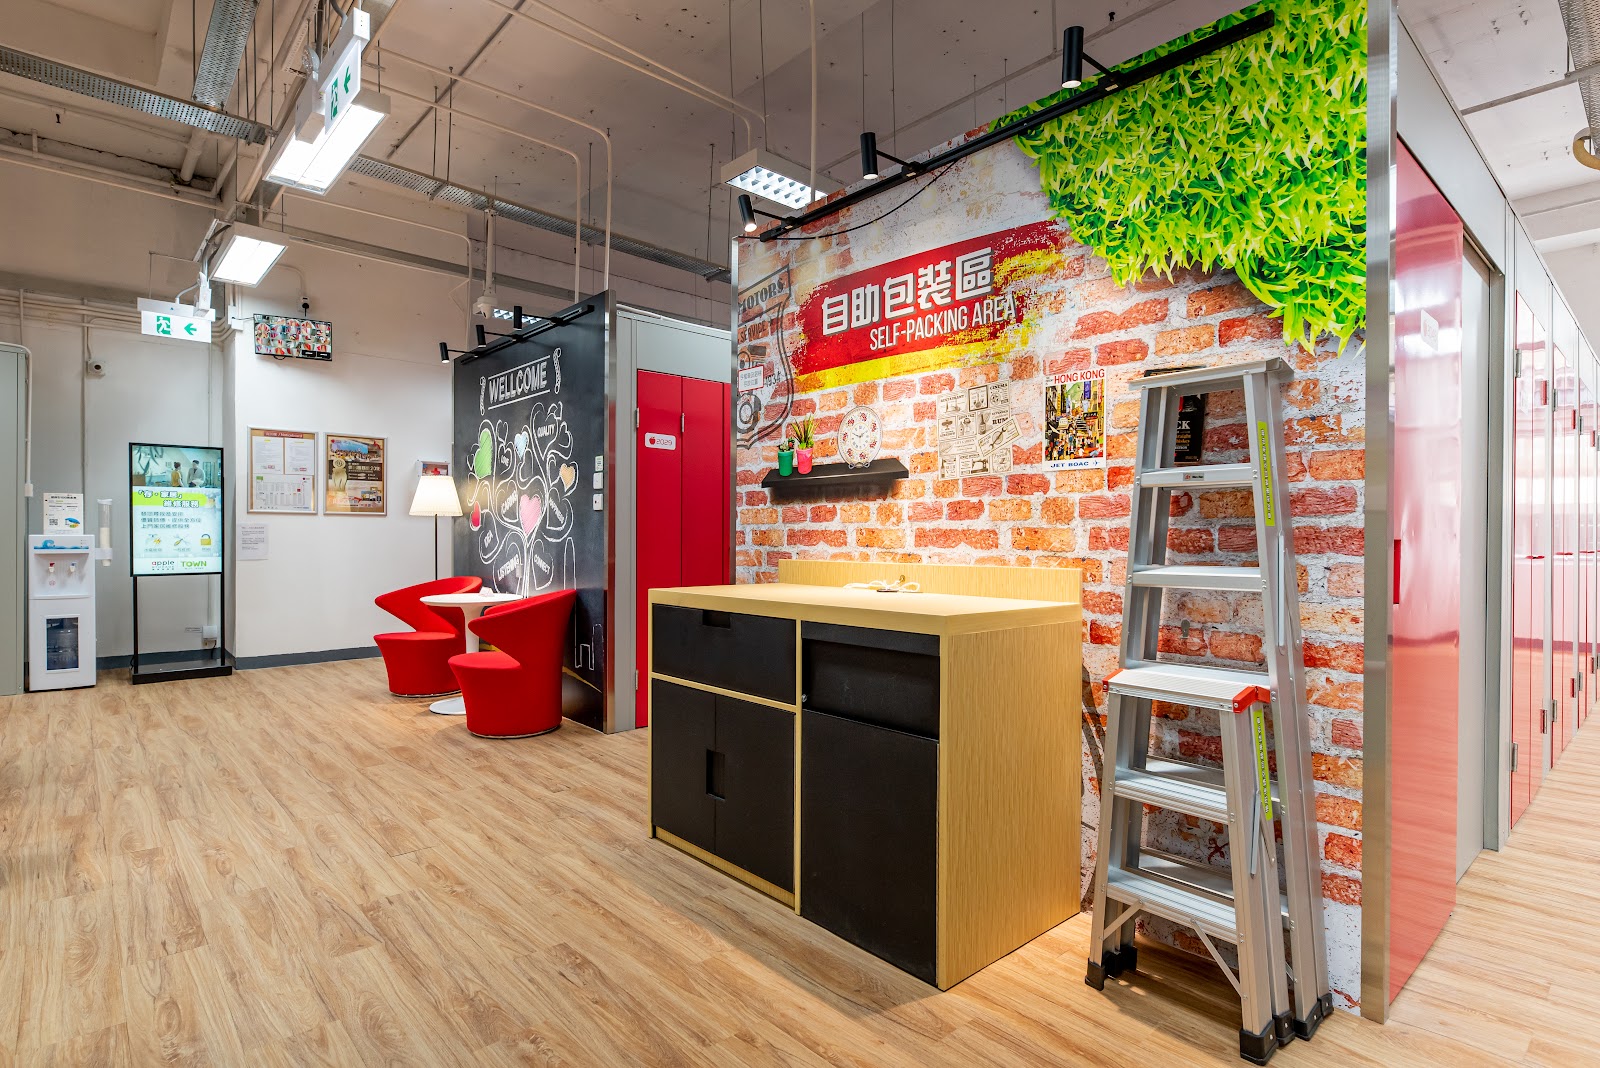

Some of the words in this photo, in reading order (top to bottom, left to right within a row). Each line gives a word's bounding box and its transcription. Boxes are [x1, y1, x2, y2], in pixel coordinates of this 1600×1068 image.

[821, 246, 995, 336] 自助包裝區
[870, 305, 969, 351] SELF-PACKING
[971, 292, 1017, 327] AREA
[489, 361, 548, 404] WELLCOME
[1053, 372, 1079, 384] HONG
[1080, 368, 1105, 381] KONG
[537, 423, 555, 438] QUALITY
[1176, 420, 1191, 430] CK
[501, 490, 518, 514] CARING
[497, 553, 519, 581] LISTENING
[533, 554, 551, 575] CONNECT
